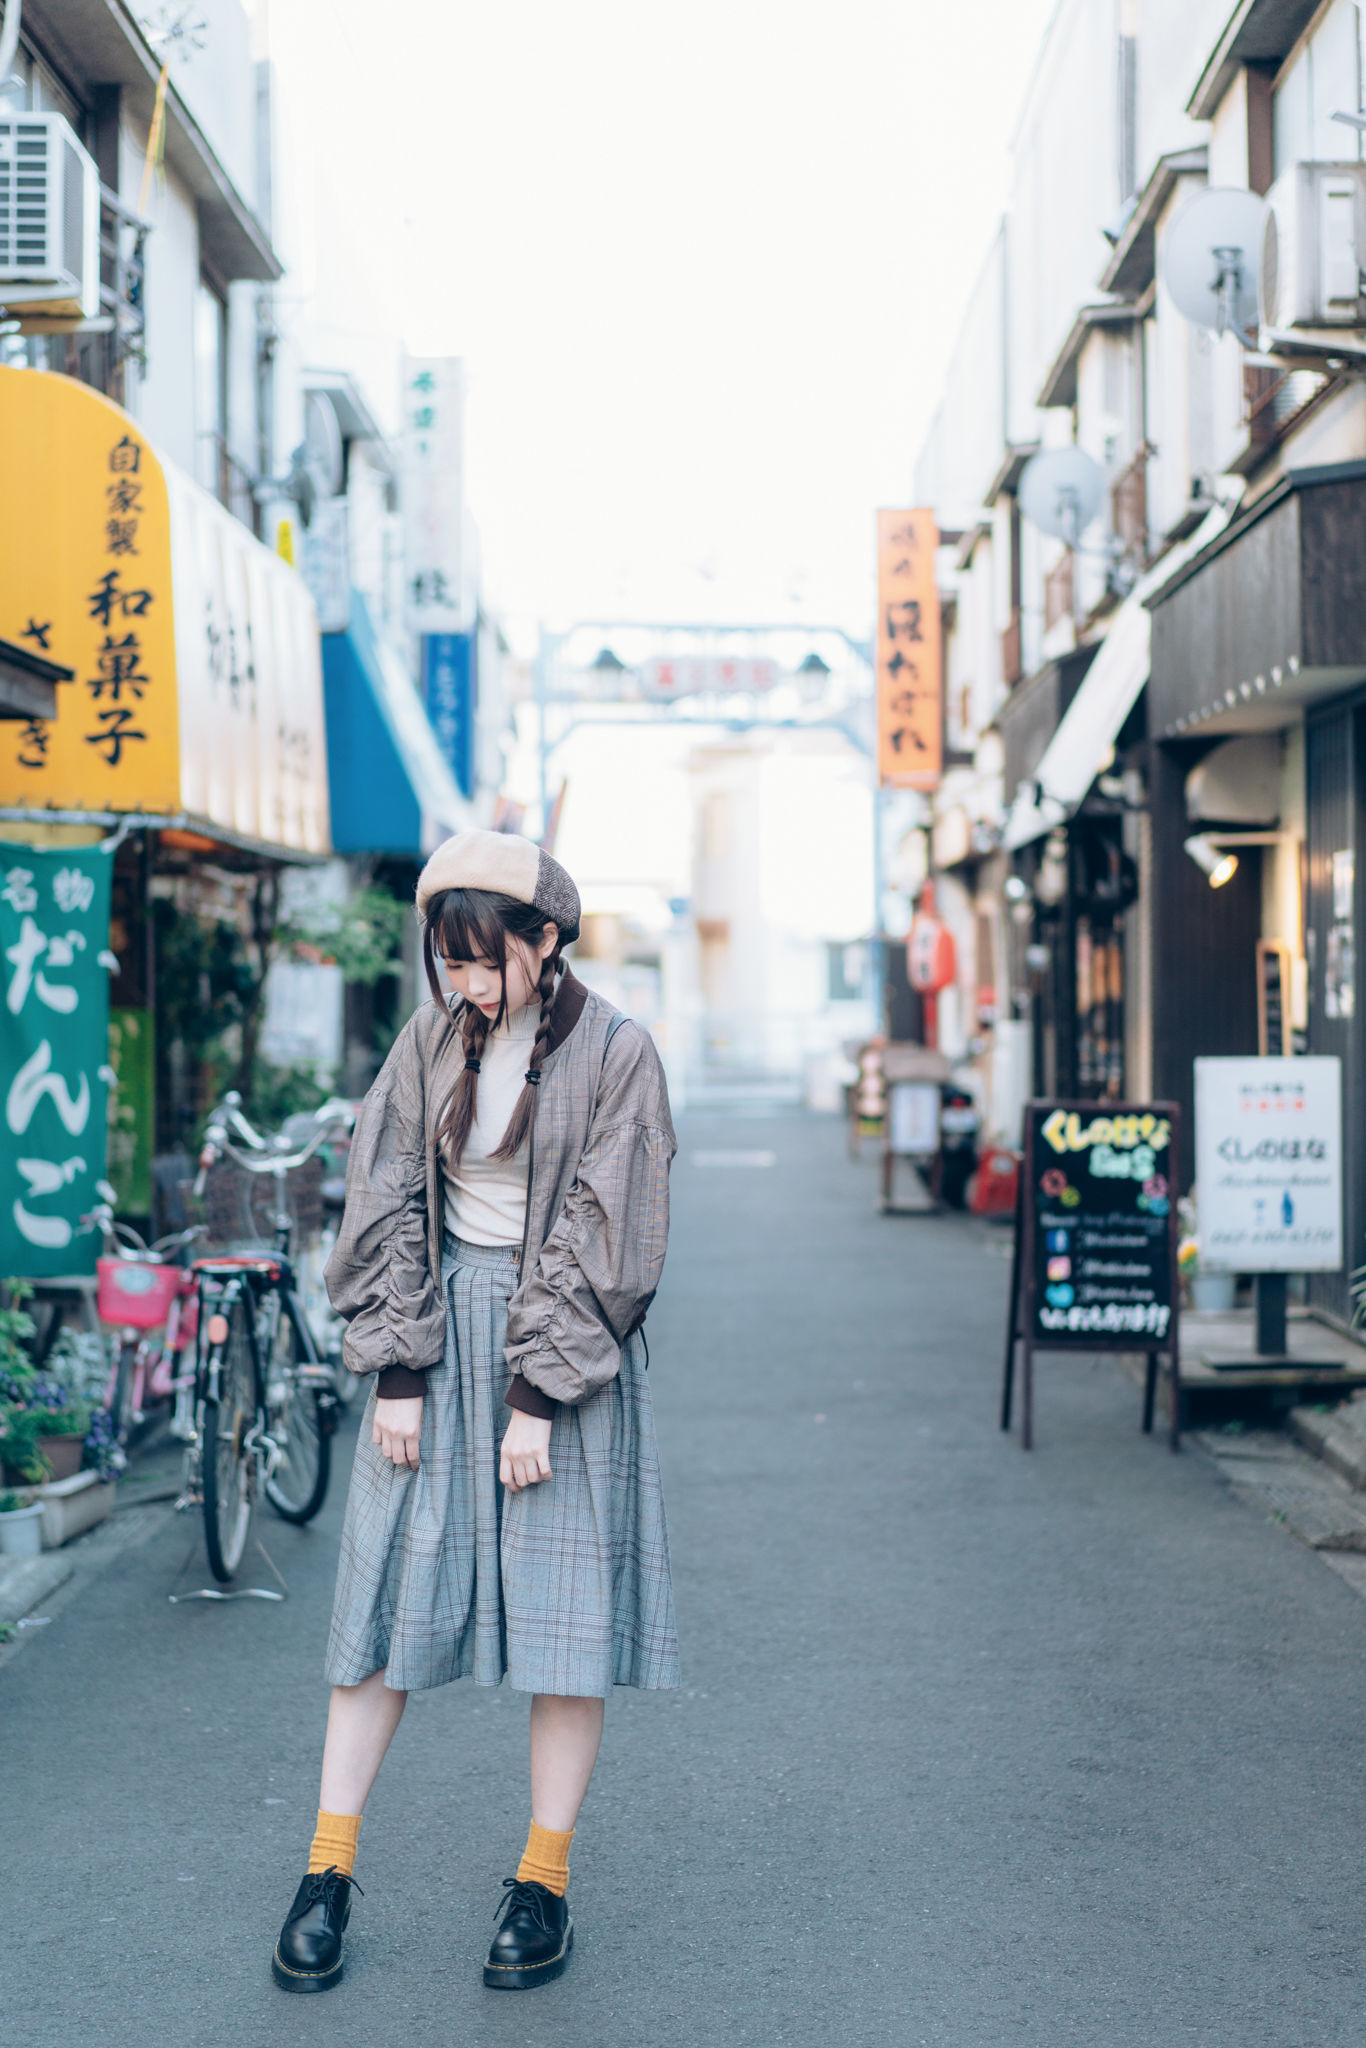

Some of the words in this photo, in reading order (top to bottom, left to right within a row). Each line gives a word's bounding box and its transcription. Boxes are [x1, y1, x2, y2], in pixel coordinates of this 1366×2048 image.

[105, 435, 144, 556] 自家製
[86, 569, 153, 766] 和菓子
[1, 866, 95, 913] 名物
[5, 915, 92, 1249] だんご
[1217, 1137, 1328, 1164] くしのはな
